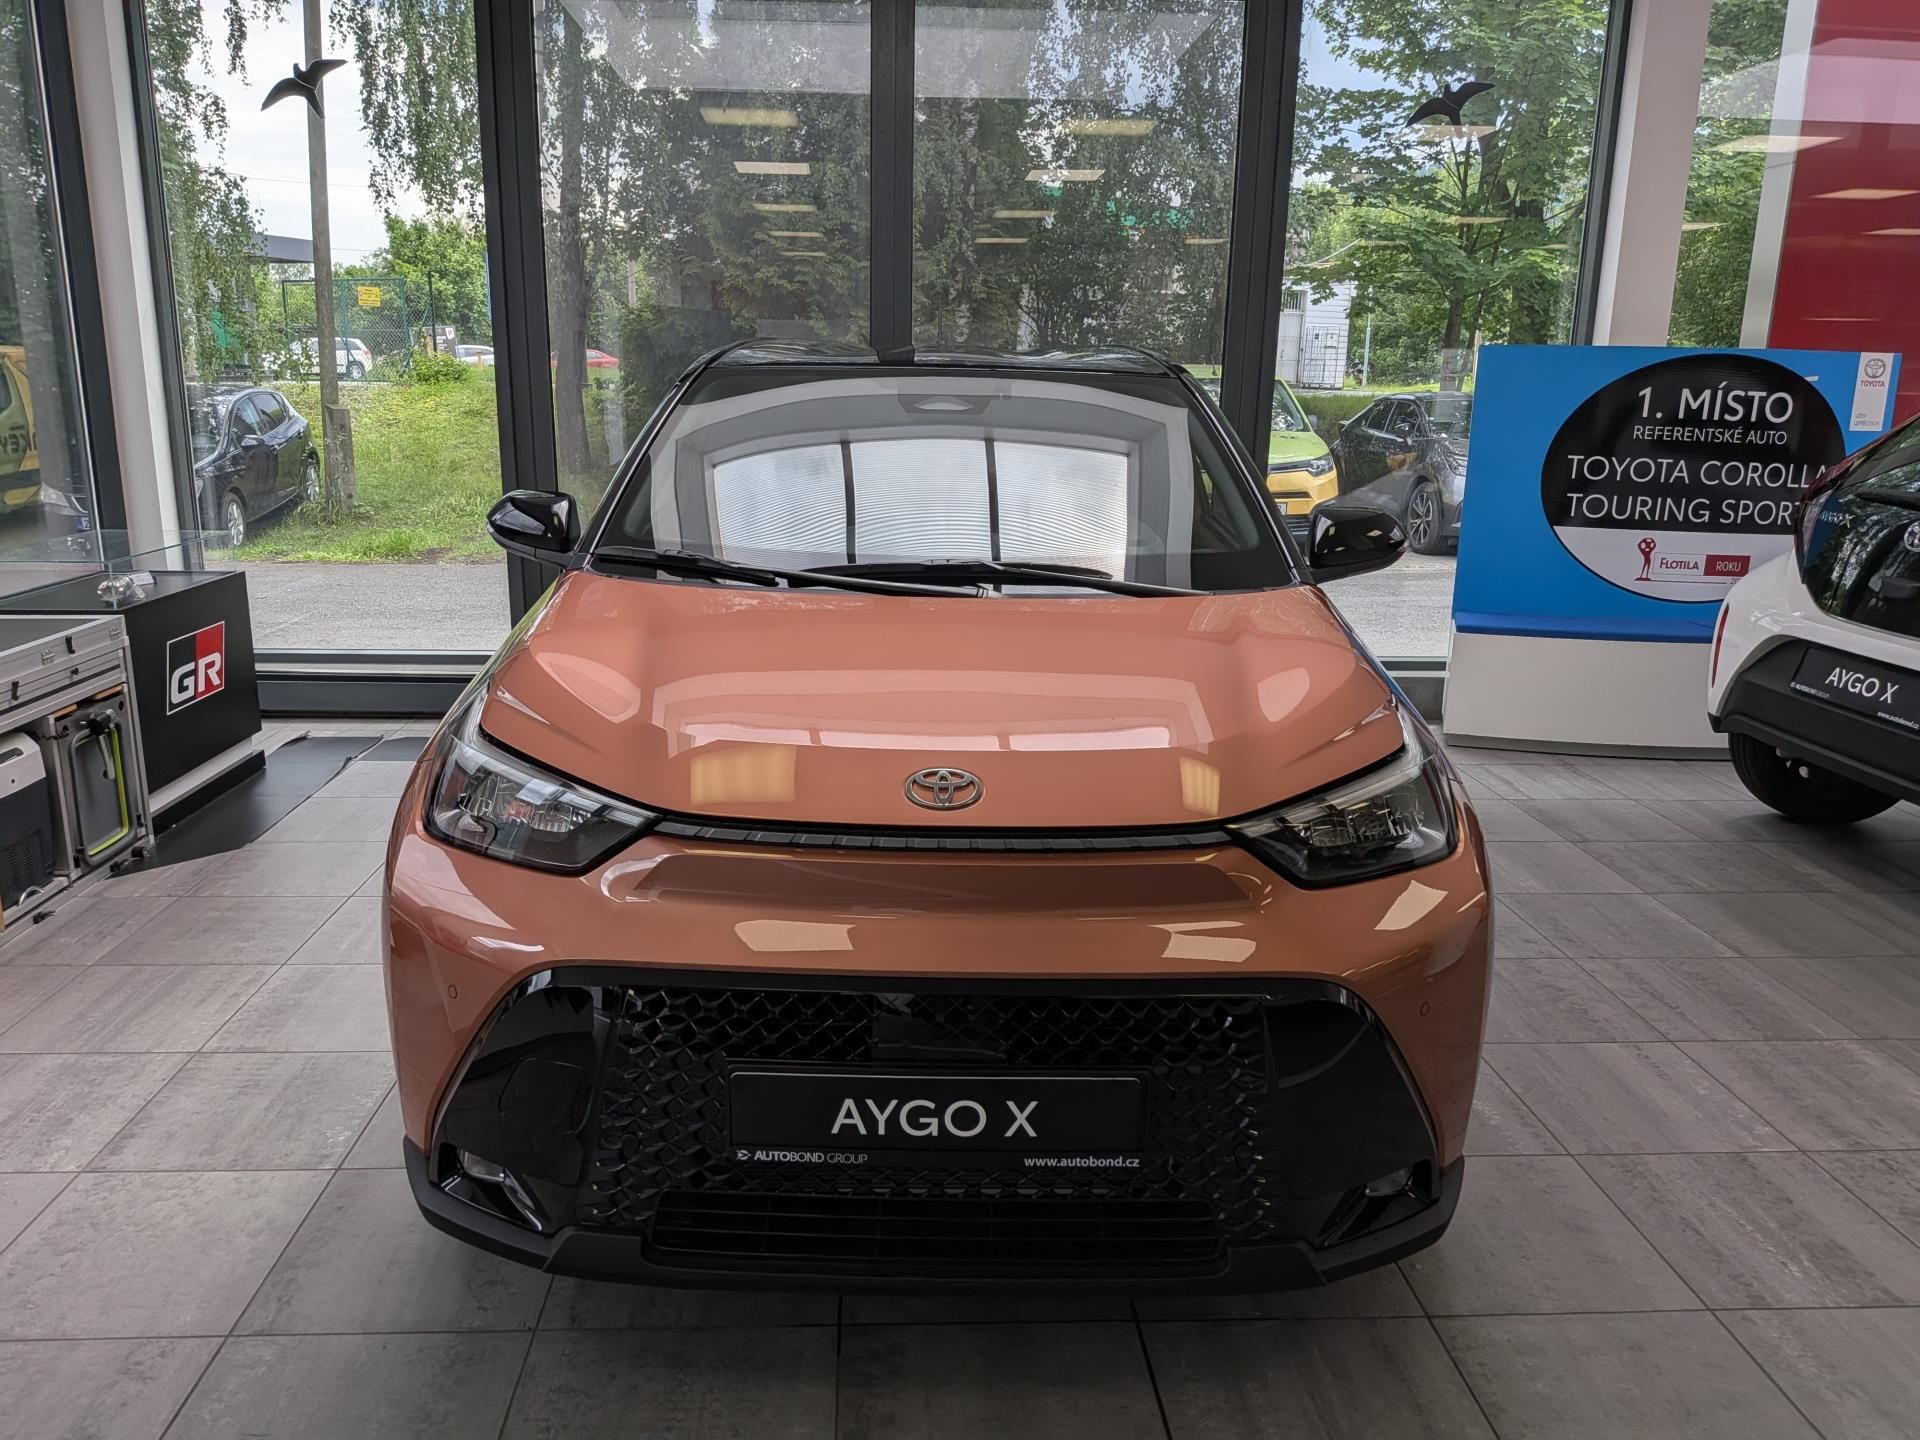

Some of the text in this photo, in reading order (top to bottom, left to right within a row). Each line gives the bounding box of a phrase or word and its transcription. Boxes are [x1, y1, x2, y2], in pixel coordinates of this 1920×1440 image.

[1860, 380, 1885, 388] TOYOTA
[1638, 381, 1794, 424] 1. MÍSTO
[1633, 425, 1788, 445] REFERENTSKÉ AUTO
[1567, 455, 1690, 485] TOYOTA
[1567, 493, 1800, 526] TOURING SPOR
[1715, 561, 1742, 572] ROKU
[170, 651, 222, 705] GR
[1825, 667, 1900, 704] AYGO X
[830, 1097, 1039, 1137] AYGO X
[754, 1150, 868, 1164] AUTOBOND GROUP
[1024, 1155, 1140, 1167] www.autobond.cz
